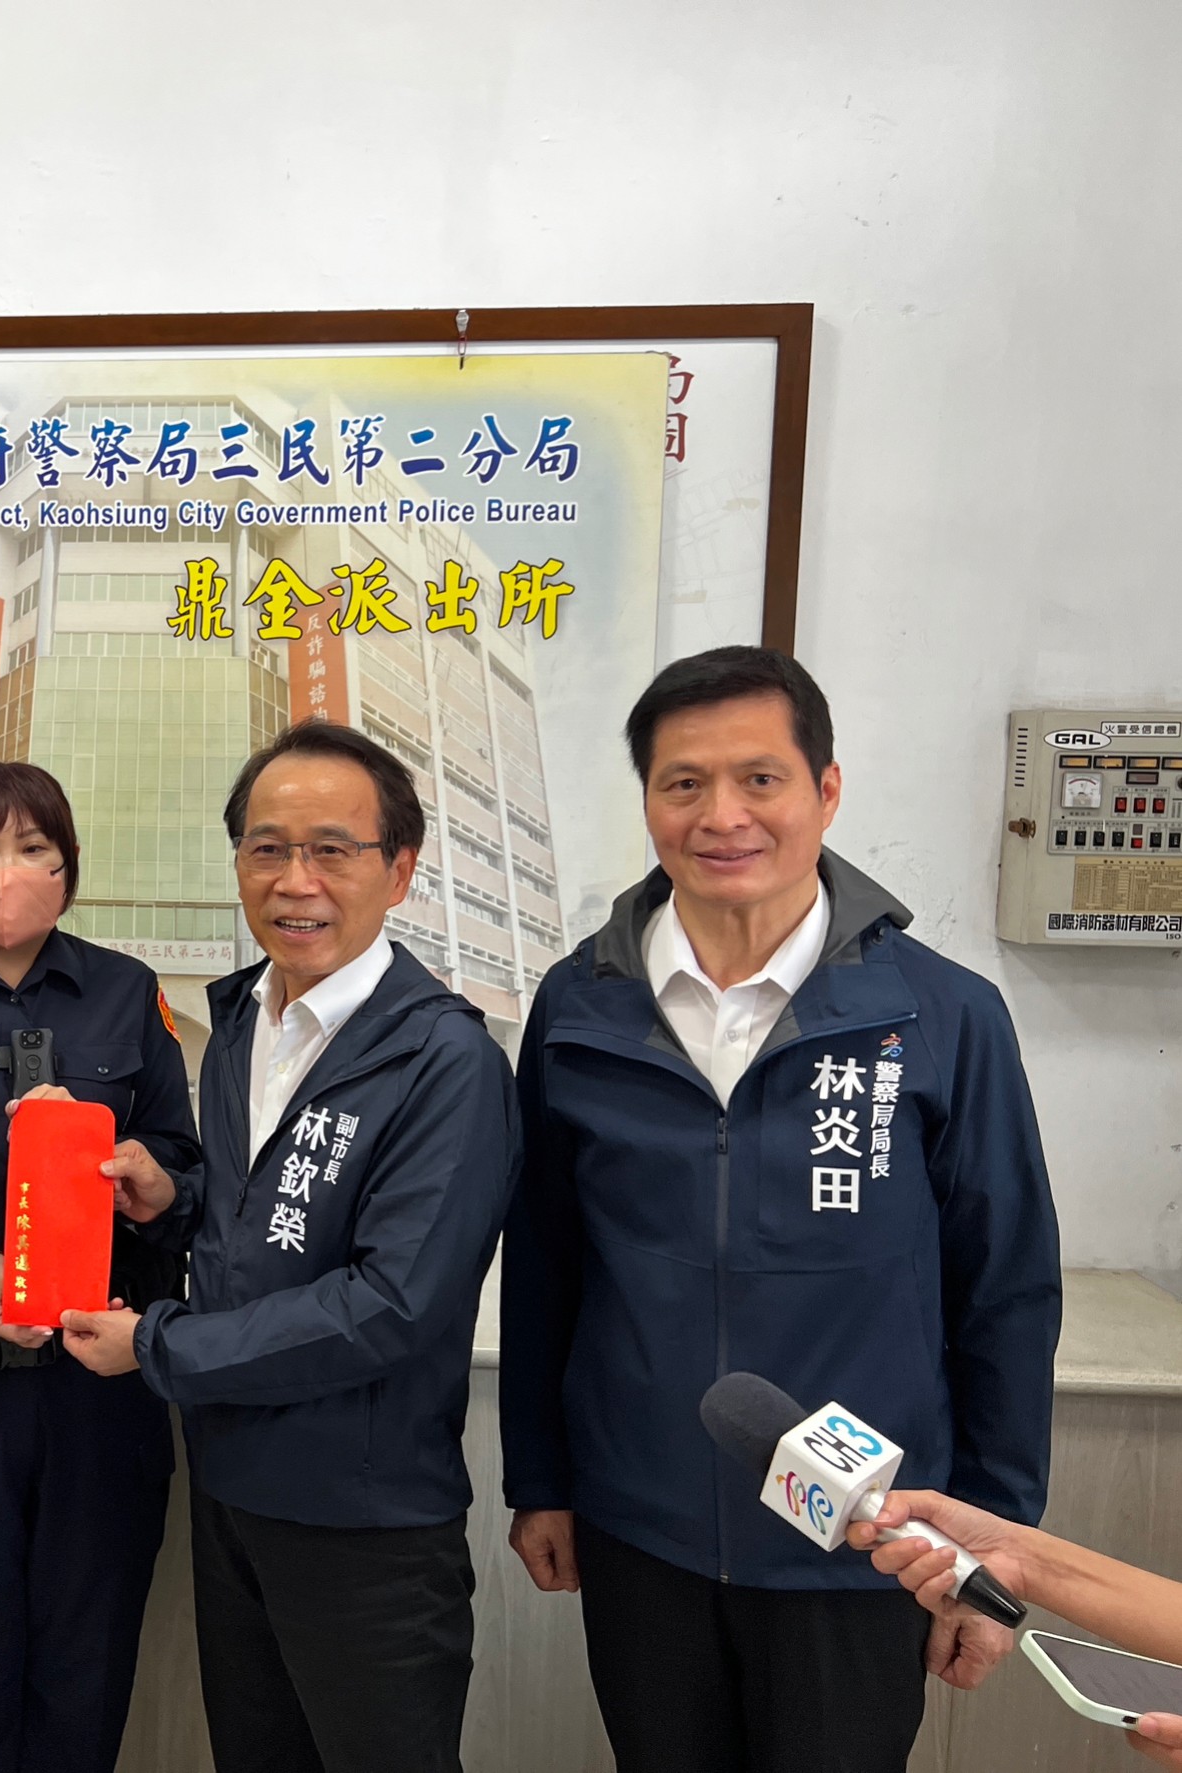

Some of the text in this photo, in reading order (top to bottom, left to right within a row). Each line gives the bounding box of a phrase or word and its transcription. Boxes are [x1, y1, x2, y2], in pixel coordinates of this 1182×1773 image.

[40, 500, 167, 530] Kaohsiung
[179, 500, 226, 531] City
[236, 500, 387, 524] Government
[399, 499, 474, 522] Police
[487, 498, 576, 522] Bureau
[166, 556, 575, 641] 鼎金派出所
[1054, 733, 1101, 746] GAL
[323, 1112, 360, 1185] 副市長
[810, 1054, 867, 1213] 林炎田
[869, 1060, 904, 1180] 警察局局長
[266, 1103, 333, 1254] 林欽榮
[803, 1415, 883, 1474] CH3
